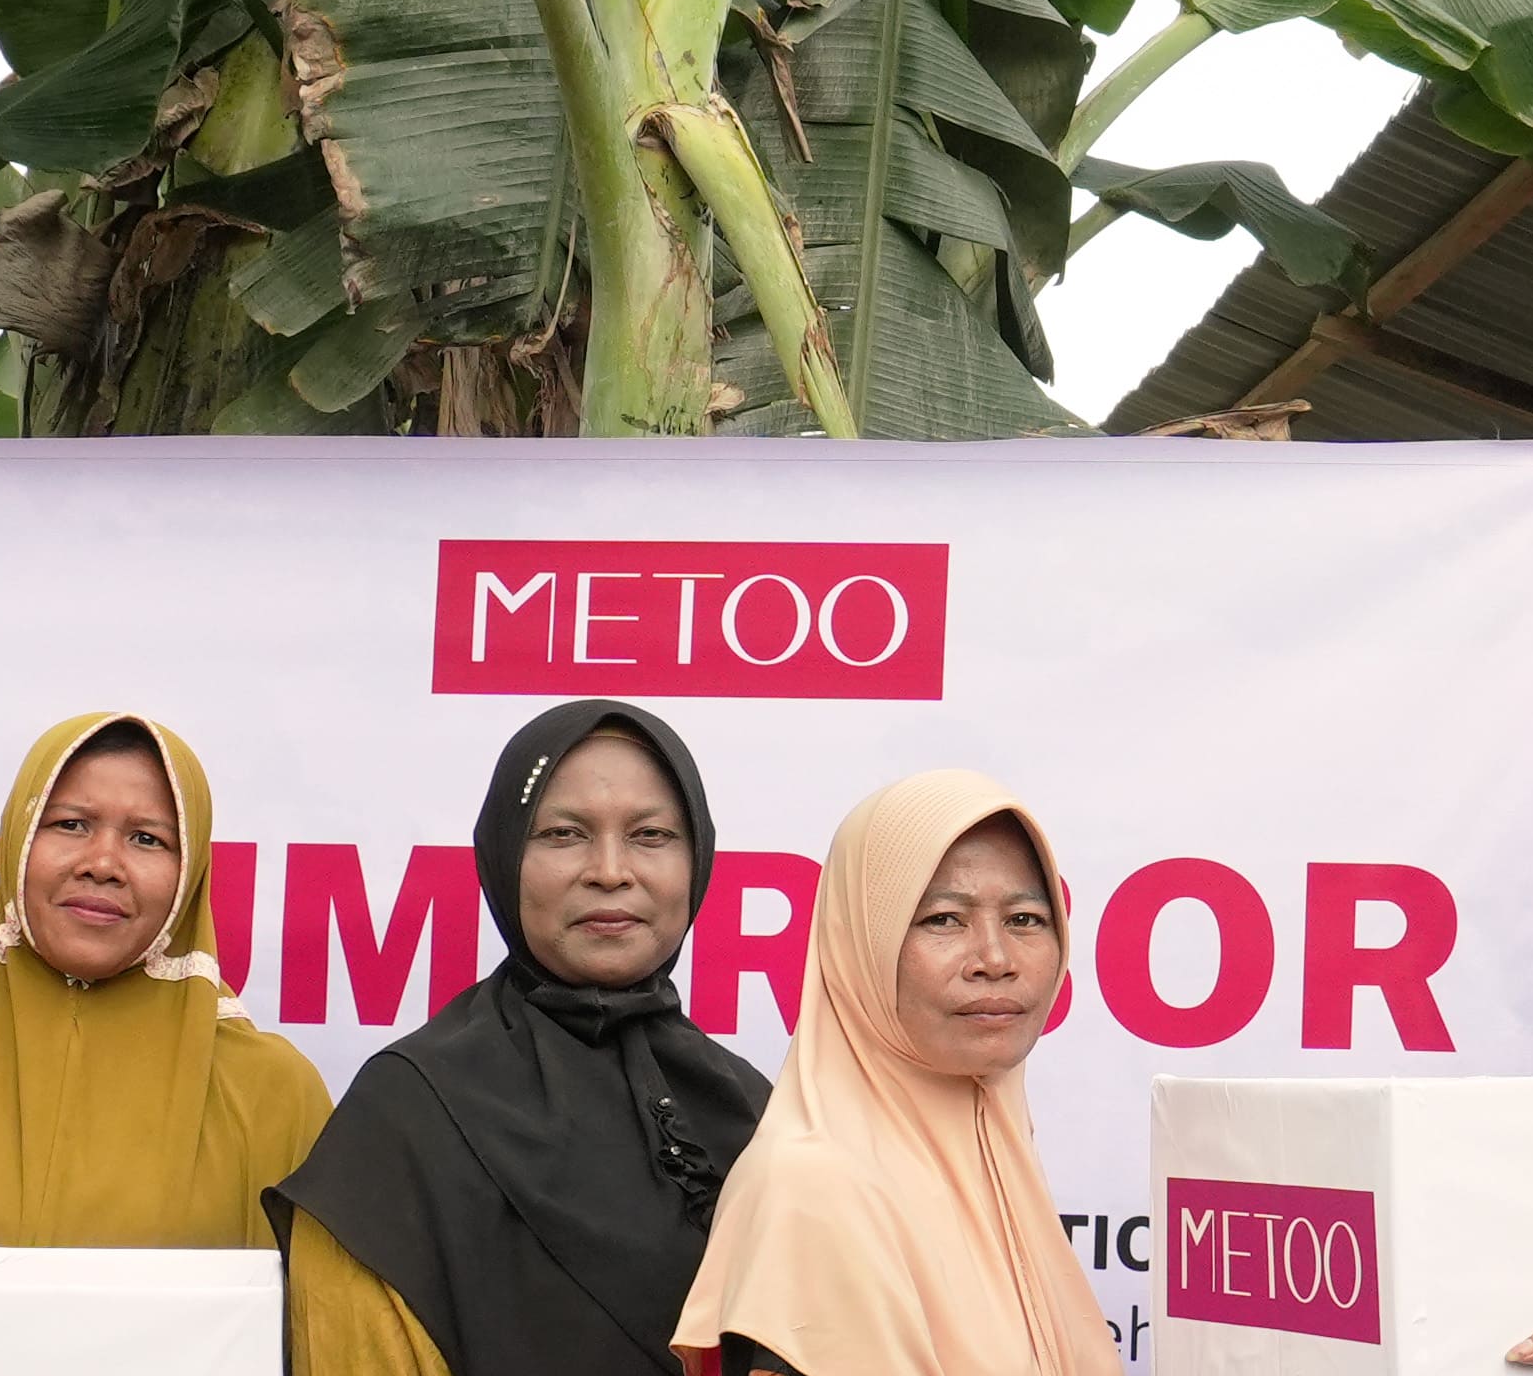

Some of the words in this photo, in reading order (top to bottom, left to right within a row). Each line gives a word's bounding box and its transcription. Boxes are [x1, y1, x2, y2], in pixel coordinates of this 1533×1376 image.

[470, 570, 910, 667] METOO
[1041, 857, 1458, 1053] OR
[1179, 1207, 1363, 1309] METOO
